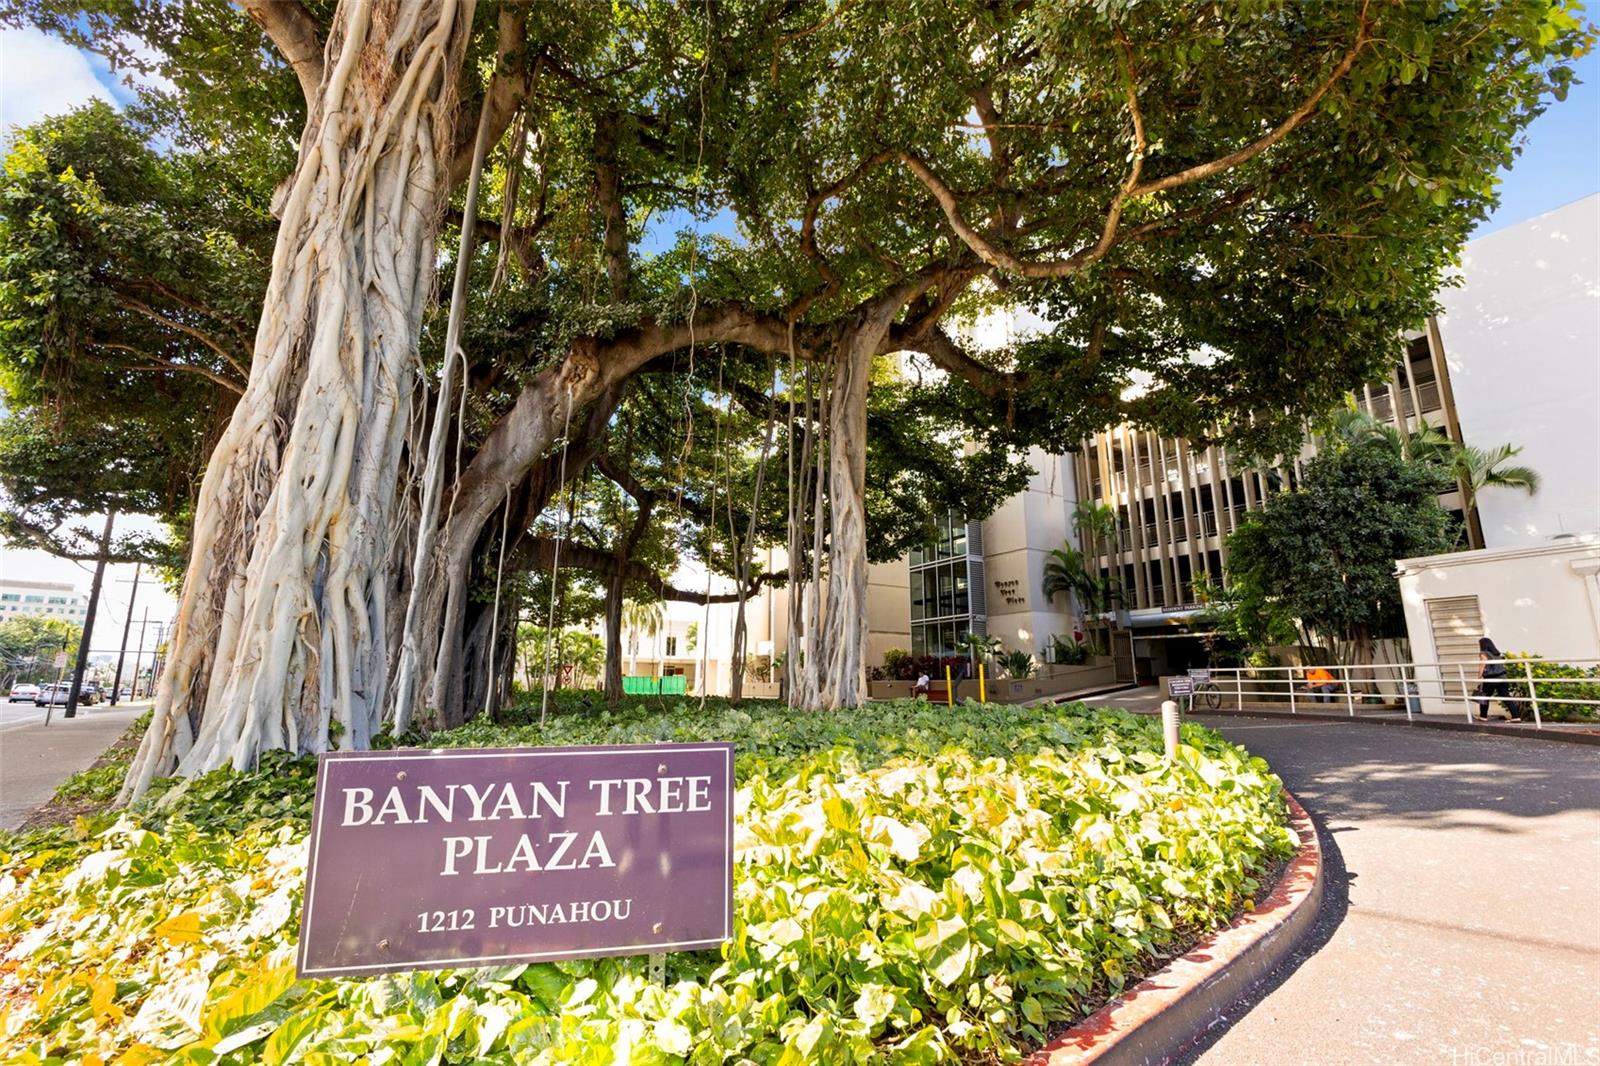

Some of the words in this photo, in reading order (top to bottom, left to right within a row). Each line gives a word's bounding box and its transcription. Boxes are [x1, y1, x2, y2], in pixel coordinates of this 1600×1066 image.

[340, 780, 571, 827] BANYAN
[589, 775, 713, 818] TREE
[439, 829, 617, 877] PLAZA
[416, 908, 476, 933] 1212
[487, 898, 633, 928] PUNAHOU
